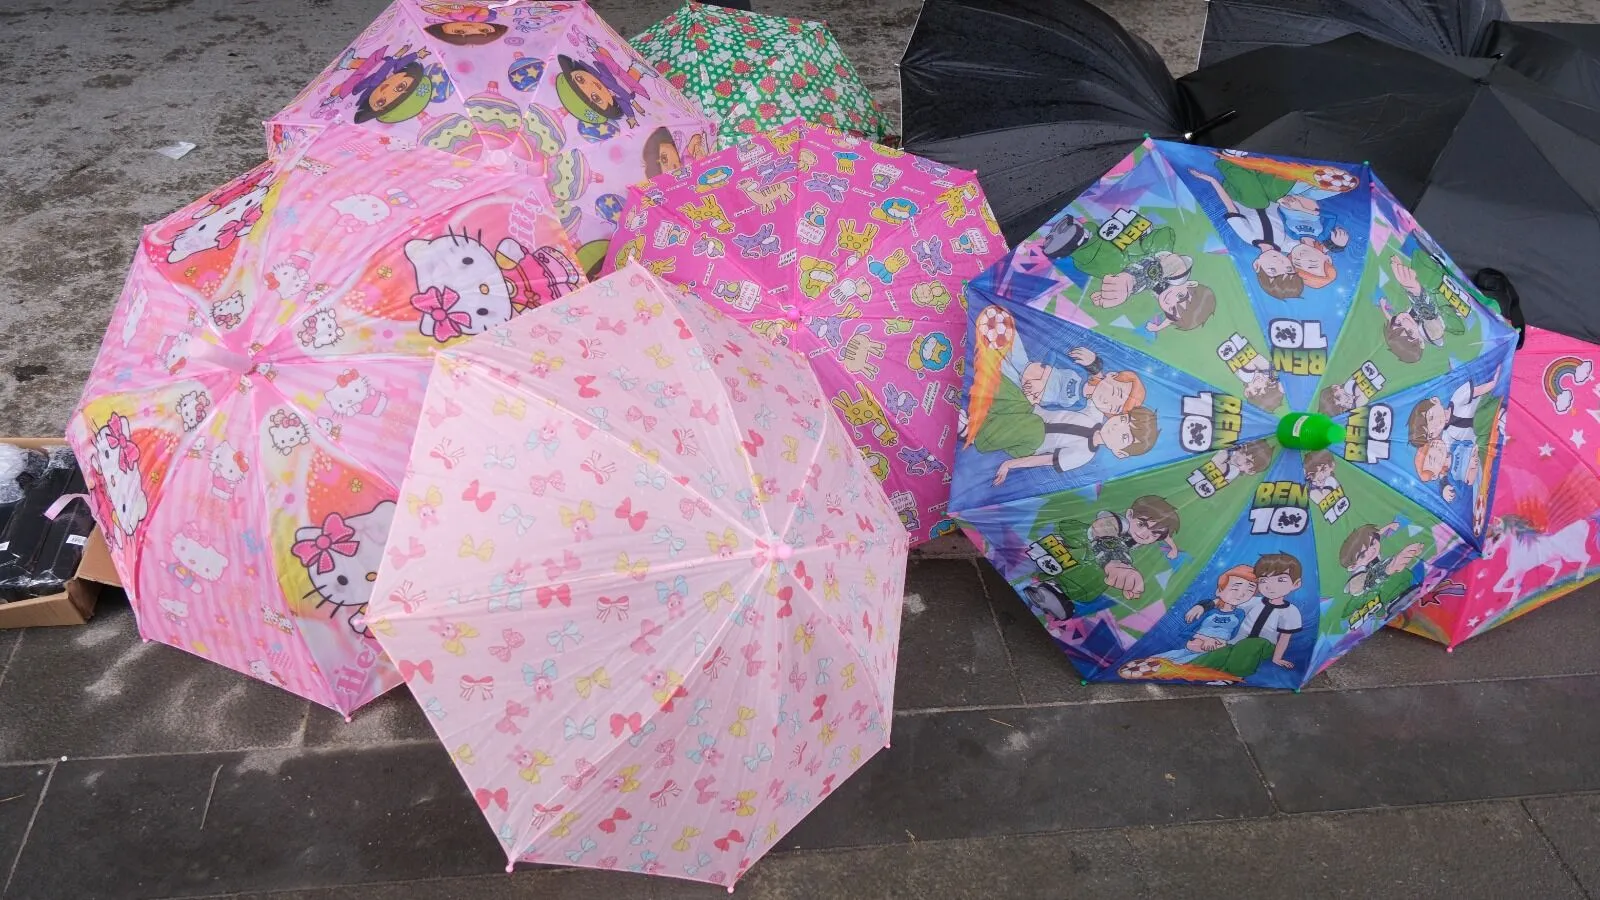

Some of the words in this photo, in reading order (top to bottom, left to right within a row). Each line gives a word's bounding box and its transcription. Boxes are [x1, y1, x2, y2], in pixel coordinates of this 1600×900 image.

[508, 188, 545, 251] itty
[1098, 208, 1137, 242] 10
[1112, 214, 1152, 252] BEN
[1439, 283, 1471, 318] BEN
[1217, 332, 1248, 361] 10
[1269, 318, 1327, 350] 10
[1227, 342, 1257, 374] BEN
[1272, 348, 1327, 376] BEN
[1352, 368, 1379, 400] BEN
[1361, 360, 1386, 391] 10
[1180, 389, 1214, 454] 10
[1212, 393, 1242, 451] BEN
[1345, 406, 1369, 462] BEN
[1367, 403, 1393, 464] 10
[1187, 469, 1216, 498] 10
[1201, 461, 1229, 491] BEN
[1253, 481, 1309, 508] BEN
[1319, 487, 1345, 515] BEN
[1323, 496, 1350, 524] 10
[1249, 506, 1309, 535] 10
[1025, 541, 1064, 577] 10
[1037, 534, 1079, 571] BEN
[1349, 594, 1380, 626] BEN
[334, 635, 384, 695] Hel
